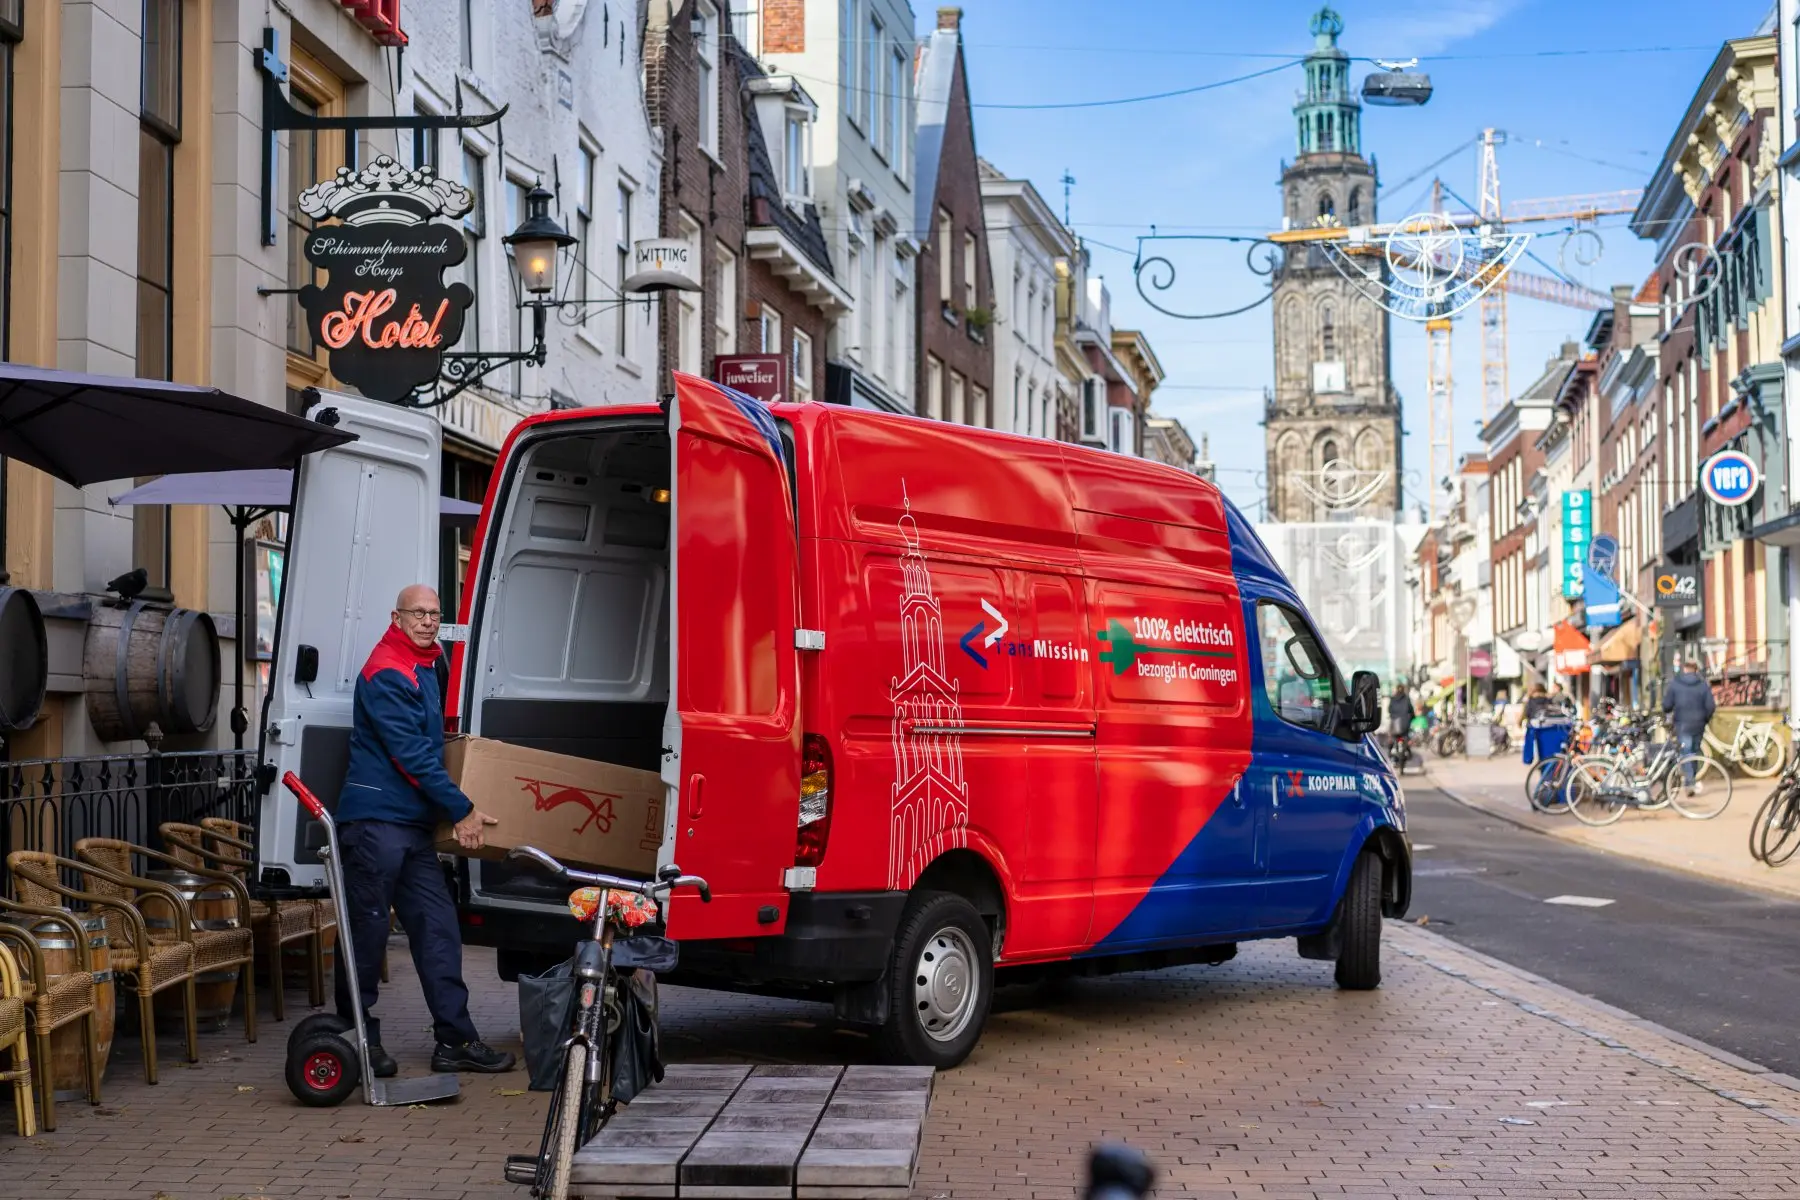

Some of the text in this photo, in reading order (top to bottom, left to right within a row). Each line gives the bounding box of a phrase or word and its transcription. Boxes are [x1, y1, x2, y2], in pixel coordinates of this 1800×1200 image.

[311, 237, 448, 259] Schimmelpenninck
[354, 258, 404, 282] Huys
[320, 287, 450, 349] Hotel
[726, 370, 774, 386] juwelier
[1569, 492, 1584, 596] DESIGN
[1134, 616, 1234, 646] 100% elektrisch
[994, 637, 1089, 662] TansMission
[1137, 658, 1237, 687] bezorgd in Groningen
[1308, 775, 1356, 791] KOOPMAN
